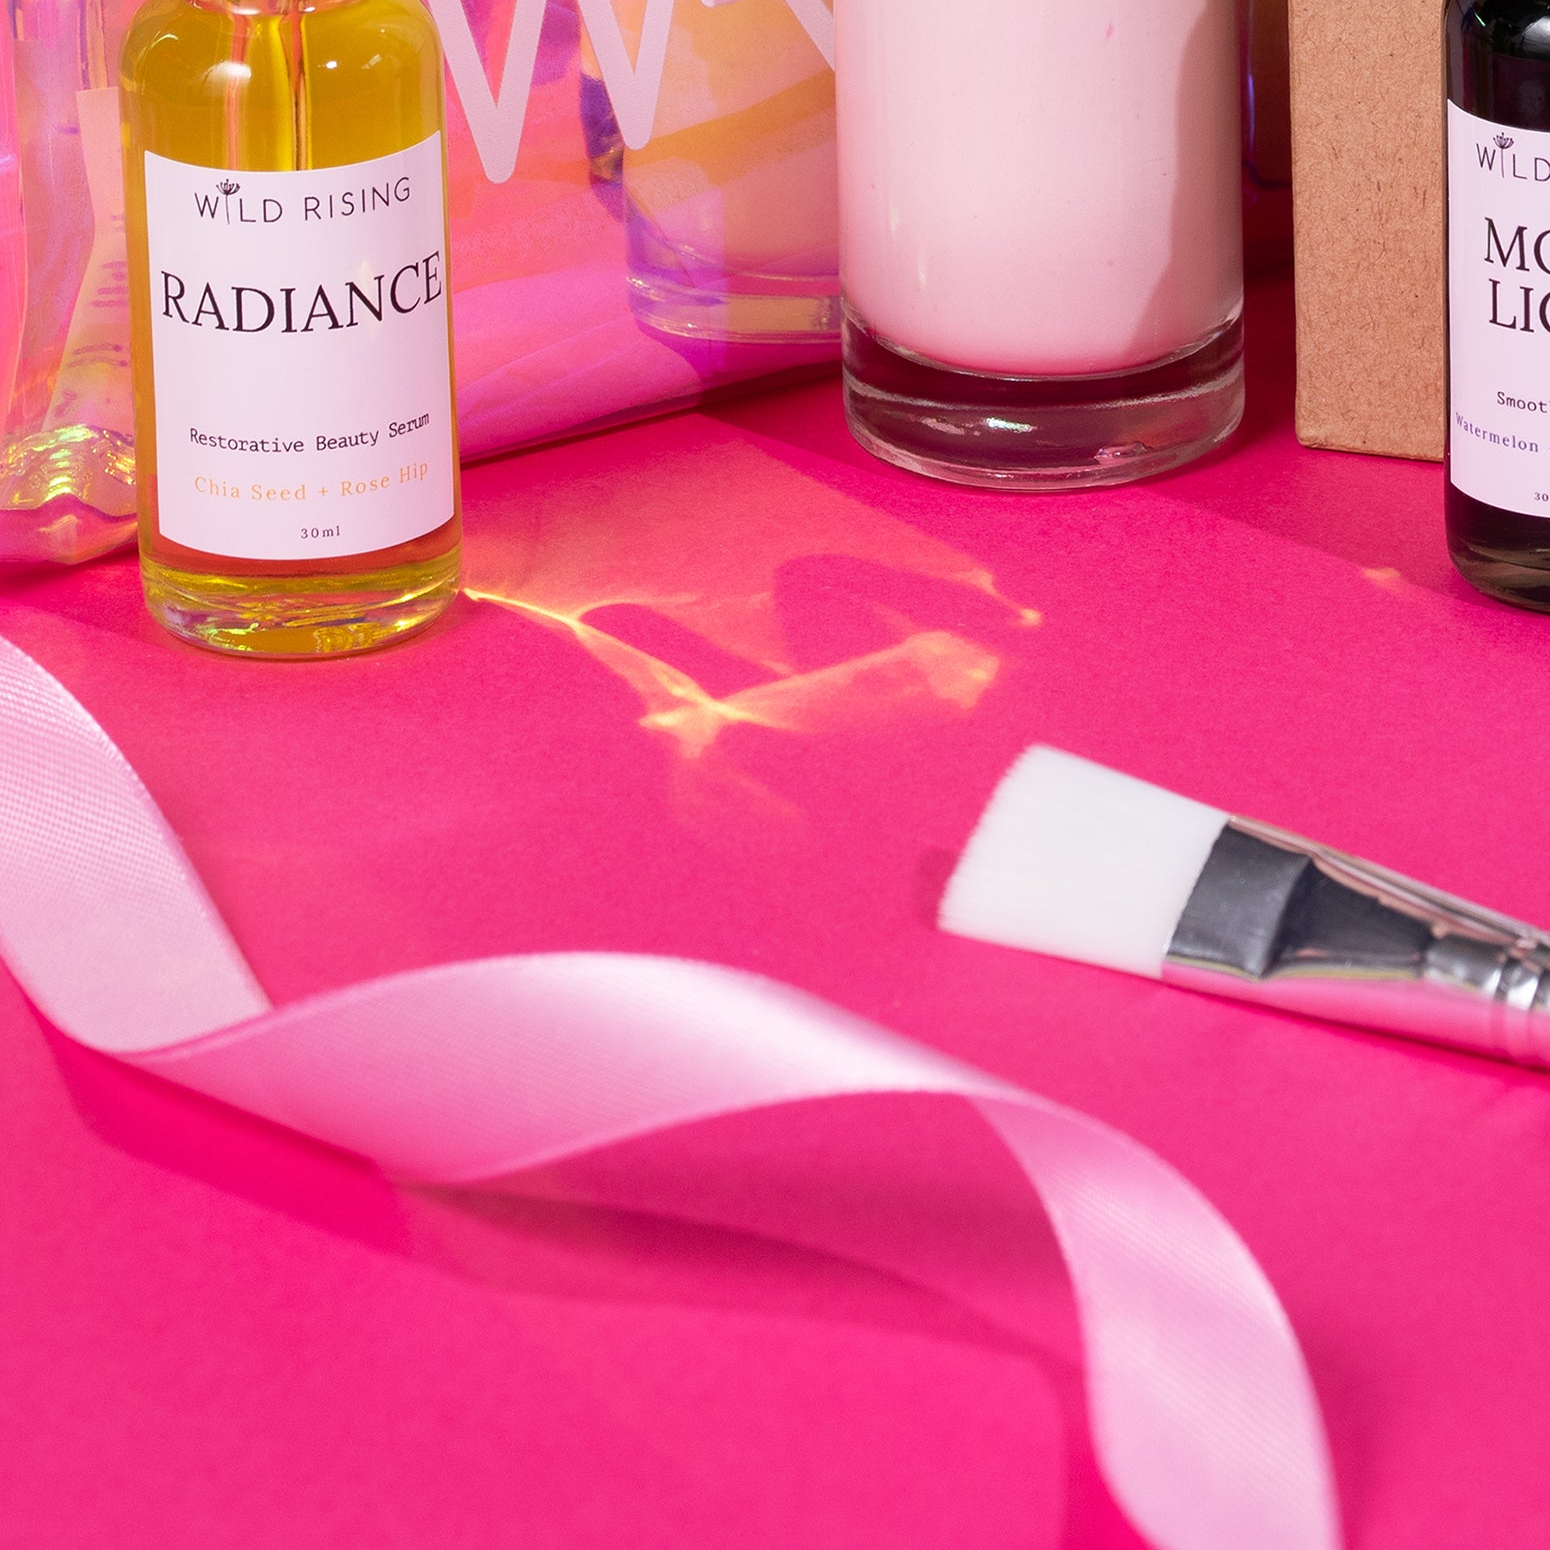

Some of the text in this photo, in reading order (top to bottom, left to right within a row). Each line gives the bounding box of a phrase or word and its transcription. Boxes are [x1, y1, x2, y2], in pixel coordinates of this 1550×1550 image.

[194, 176, 412, 226] WILD RISING
[160, 250, 443, 335] RADIANCE
[189, 410, 431, 455] Restorative Beauty Serum
[1455, 410, 1540, 454] Watermelon
[193, 460, 430, 501] Chia Seed + Rose Hip
[299, 524, 341, 540] 30ml
